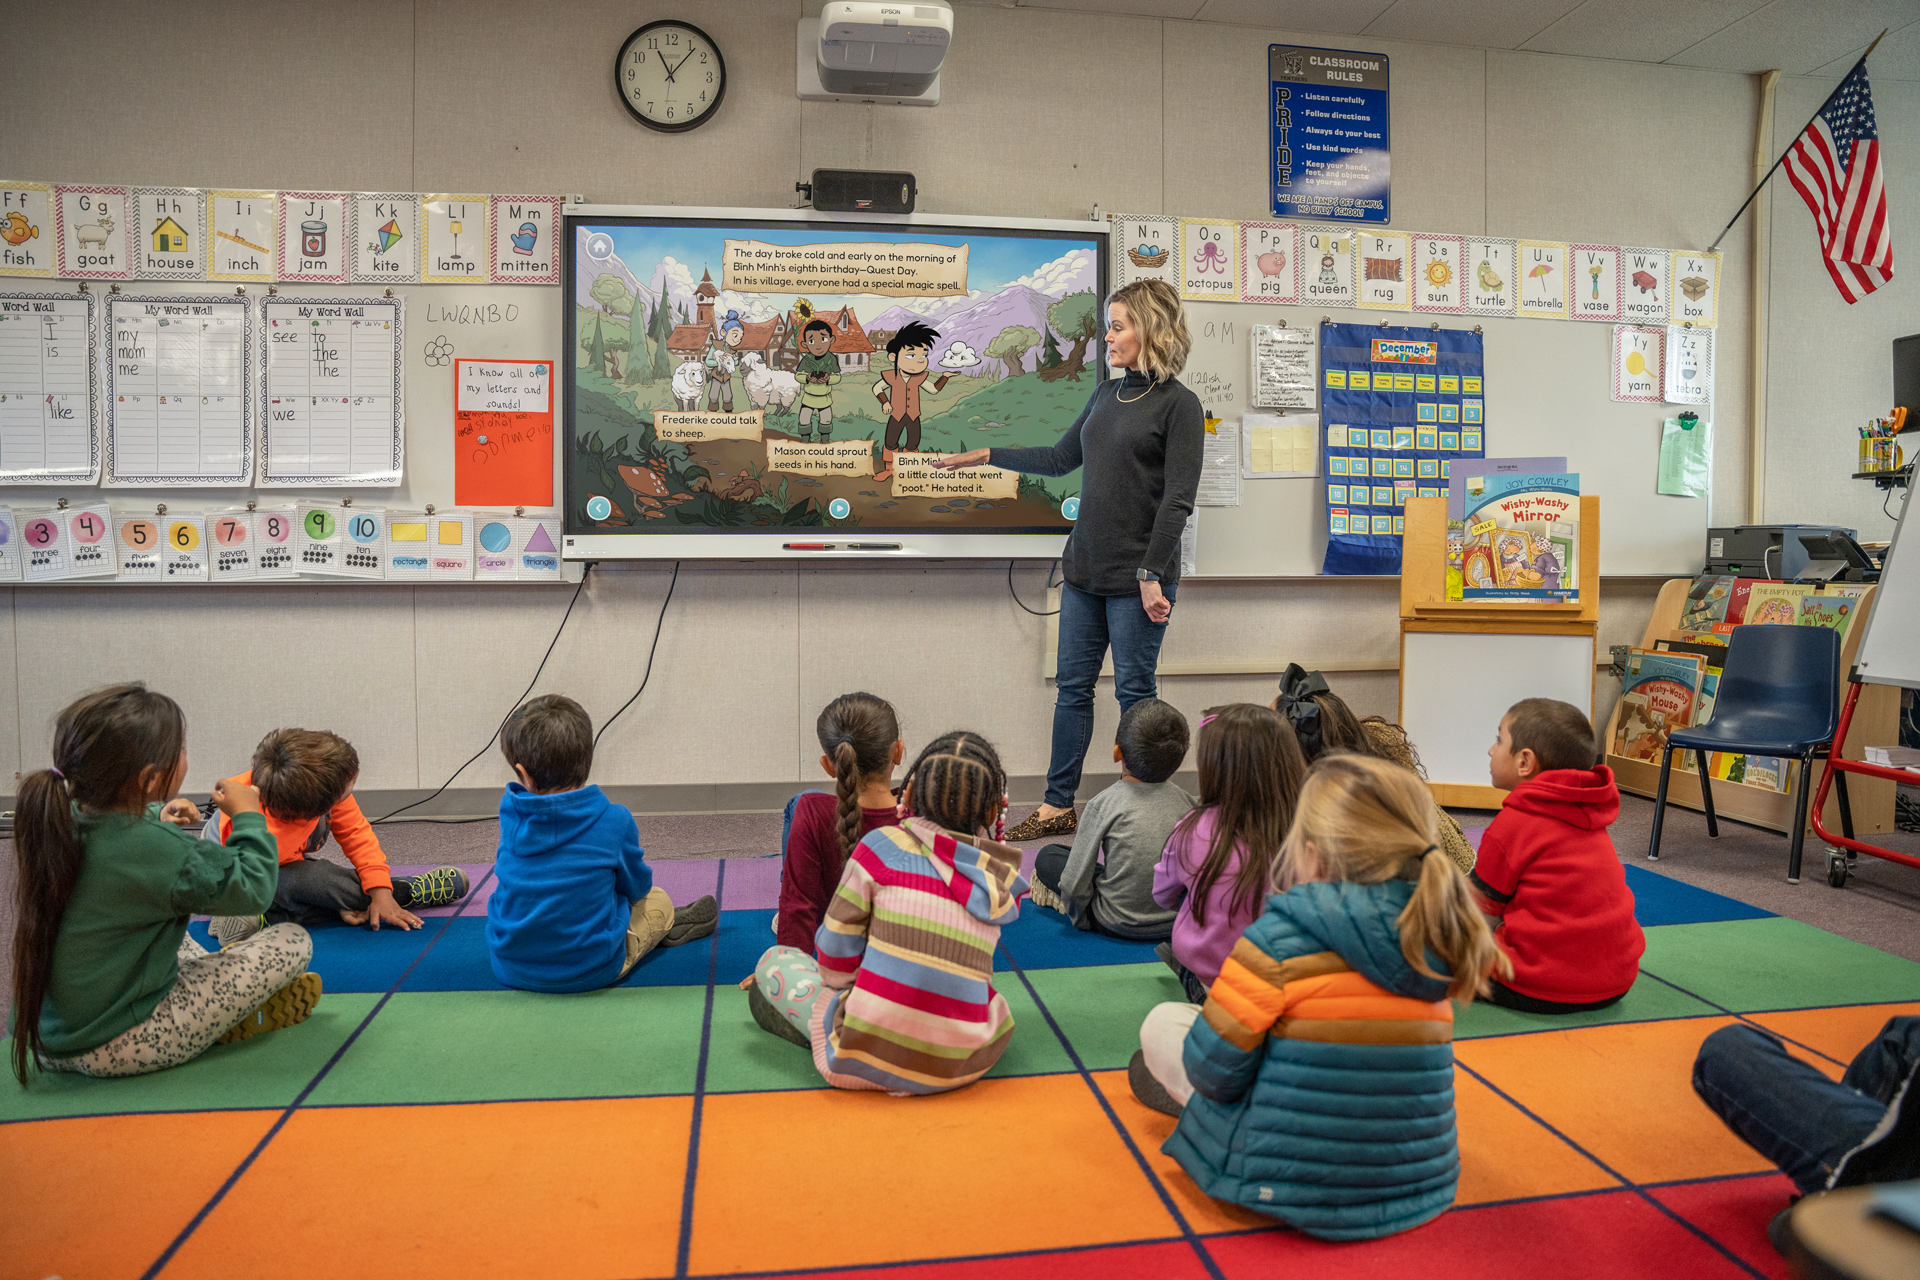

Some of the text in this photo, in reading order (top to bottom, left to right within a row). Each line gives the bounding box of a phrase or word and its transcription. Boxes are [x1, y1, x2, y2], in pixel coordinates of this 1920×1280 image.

[1310, 56, 1378, 70] CLASSROOM
[1326, 70, 1363, 82] RULES
[1305, 92, 1365, 105] Listen carefully
[1306, 110, 1370, 121] Follow directions
[1276, 88, 1292, 186] PRIDE
[1306, 126, 1332, 136] Always
[1340, 146, 1363, 154] words
[1306, 160, 1324, 168] Keep
[1316, 178, 1348, 186] yourself
[1342, 172, 1370, 180] objects
[1277, 194, 1290, 202] WE
[1291, 195, 1305, 204] ARE
[1306, 196, 1313, 204] A
[1314, 196, 1338, 206] HANDS
[1340, 198, 1354, 208] OFF
[1298, 205, 1364, 217] NO BULLY SCHOOL!
[3, 251, 35, 266] fish
[77, 253, 116, 268] goat
[148, 254, 194, 269] house
[734, 248, 752, 258] The
[755, 250, 772, 259] day
[775, 250, 802, 259] broke
[804, 251, 825, 259] cold
[827, 252, 845, 260] and
[848, 252, 872, 262] early
[888, 253, 904, 262] the
[906, 254, 944, 264] morning
[946, 255, 956, 263] of
[228, 256, 259, 270] inch
[298, 257, 328, 272] jam
[373, 258, 400, 272] kite
[438, 257, 475, 274] lamp
[501, 258, 549, 272] mitten
[757, 263, 786, 272] Minh's
[789, 263, 818, 274] eighth
[898, 267, 918, 277] Day.
[734, 276, 741, 285] In
[744, 276, 757, 285] his
[760, 277, 794, 287] village,
[796, 279, 840, 288] everyone
[842, 279, 860, 287] had
[871, 280, 904, 289] special
[906, 280, 934, 291] magic
[937, 281, 961, 291] spell.
[1187, 278, 1233, 291] octopus
[1261, 282, 1280, 295] pig
[1309, 284, 1348, 296] queen
[1374, 288, 1394, 300] rug
[1428, 292, 1449, 303] sun
[1476, 295, 1506, 307] turtle
[1522, 298, 1563, 310] umbrella
[1583, 301, 1610, 312] vase
[1627, 303, 1664, 315] wagon
[145, 305, 213, 316] My Word Wall
[298, 306, 364, 318] My Word Wall
[1684, 304, 1703, 317] box
[44, 323, 58, 340] I
[272, 332, 298, 342] see
[311, 328, 326, 343] to
[118, 330, 138, 350] my
[46, 343, 58, 358] is
[118, 346, 146, 359] mom
[312, 342, 339, 360] the
[1380, 343, 1430, 355] December
[119, 364, 140, 376] me
[313, 360, 340, 377] The
[468, 366, 472, 376] I
[510, 368, 523, 378] all
[466, 383, 541, 394] my letters and
[1628, 382, 1651, 392] yarn
[50, 402, 74, 420] like
[486, 400, 521, 411] sounds!
[272, 410, 296, 421] we
[662, 415, 758, 425] Frederike could talk
[662, 429, 705, 439] to sheep.
[774, 447, 867, 458] Mason could sprout
[774, 460, 801, 469] seeds
[815, 460, 828, 469] his
[830, 461, 856, 469] hand.
[922, 458, 940, 466] Min
[907, 470, 927, 479] little
[930, 471, 955, 479] cloud
[932, 484, 944, 492] He
[1506, 477, 1569, 490] JOY COWLEY
[1501, 497, 1570, 512] Wishy-Washy
[1513, 510, 1561, 524] Mirror
[1474, 522, 1493, 533] SALE
[32, 548, 58, 558] three
[266, 546, 287, 555] eight
[310, 543, 328, 551] nine
[356, 546, 370, 554] ten
[220, 550, 247, 558] seven
[393, 557, 428, 566] rectangle
[436, 560, 462, 570] square
[486, 559, 506, 567] circle
[526, 558, 555, 567] triangle
[1802, 599, 1822, 617] Salt in
[1804, 611, 1834, 628] His Shoes
[1648, 685, 1689, 705] Wishy-Washy
[1652, 696, 1678, 712] Mouse
